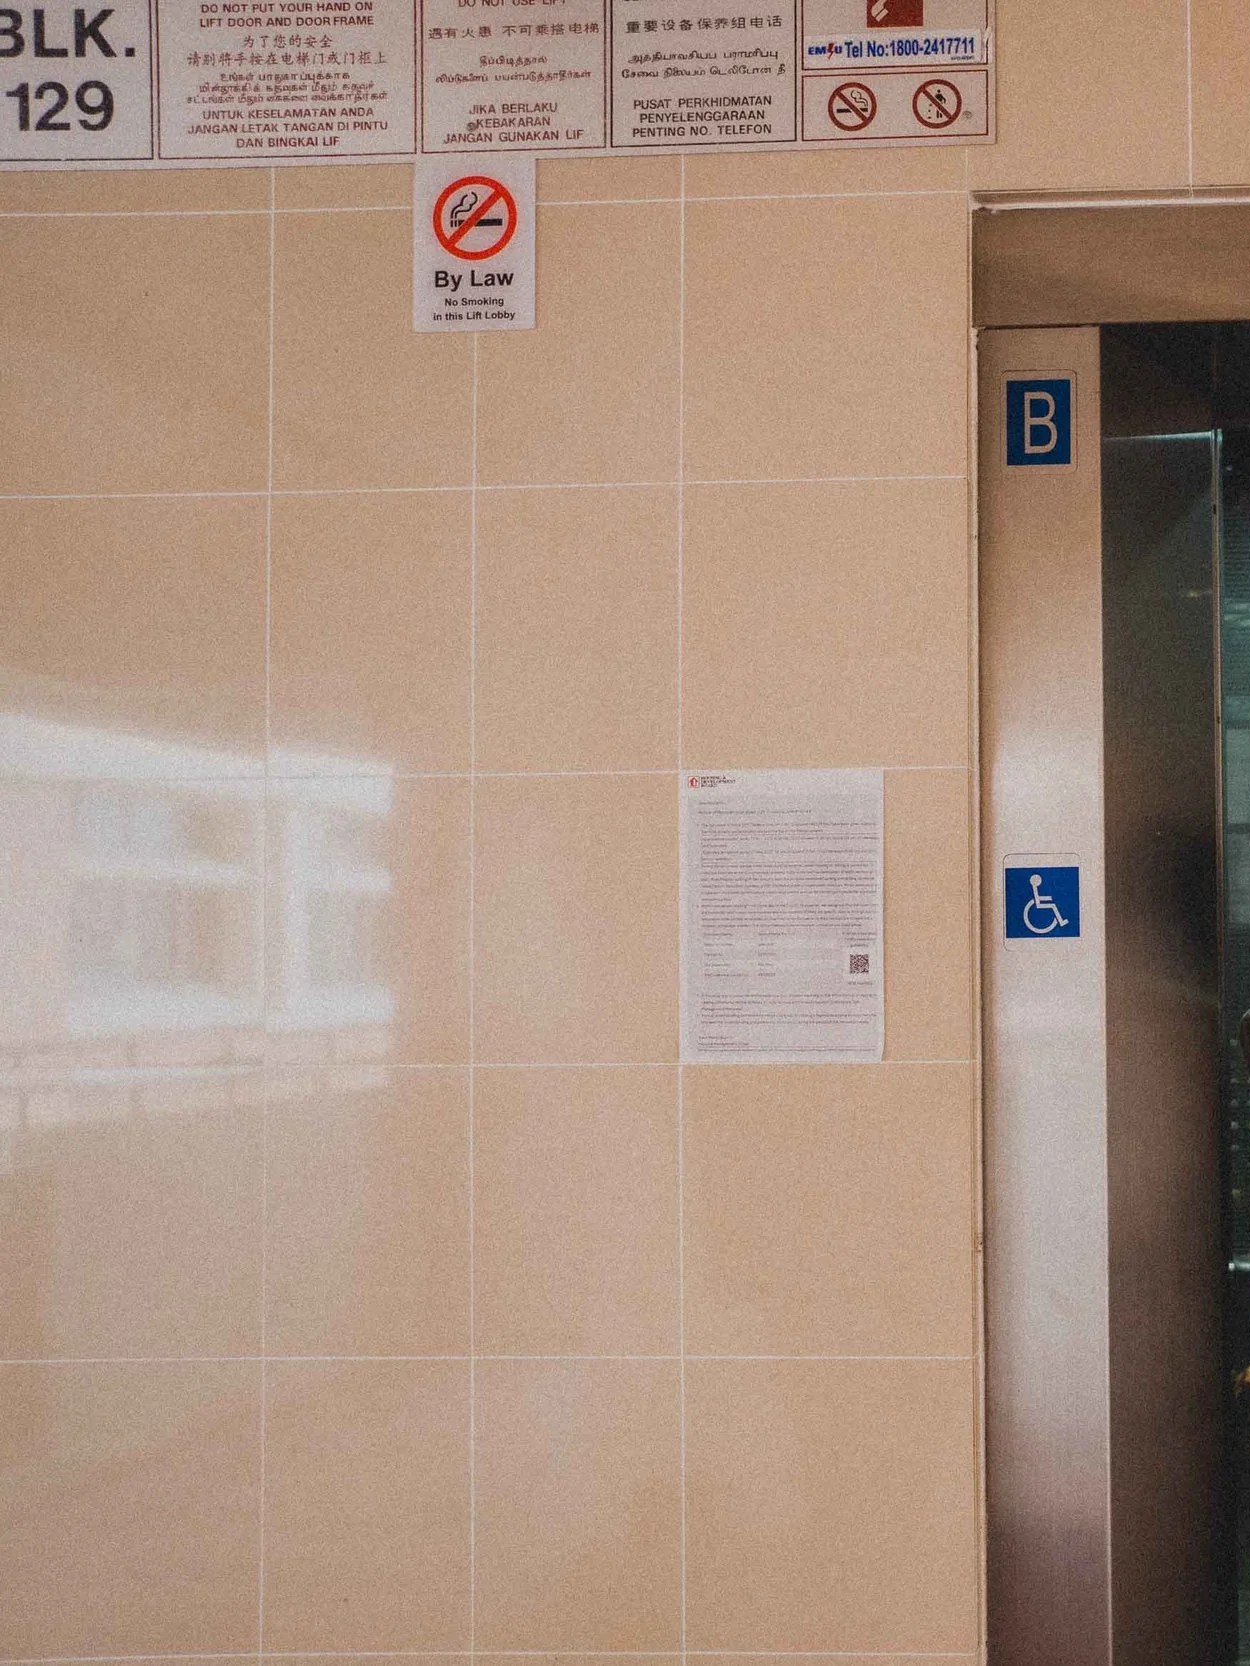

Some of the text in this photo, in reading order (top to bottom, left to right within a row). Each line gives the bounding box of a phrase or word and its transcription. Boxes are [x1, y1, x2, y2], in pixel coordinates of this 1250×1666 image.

[200, 1, 374, 14] DO NOT PUT YOUR HAND ON
[199, 15, 375, 28] LIFT DOOR AND DOOR FRAME
[626, 16, 783, 34] 重要设备保养组电话
[0, 9, 135, 58] BLK.
[428, 23, 600, 39] 遇有火患 不可乘搭电梯
[242, 33, 334, 49] 为了您的安全
[844, 40, 864, 58] Tel
[186, 51, 389, 67] 请别将手按在电梯门或门框上
[6, 80, 114, 131] 129
[468, 102, 559, 116] JIKA BERLAKU
[633, 95, 773, 110] PUSAT PERKHIDMATAN
[202, 107, 375, 120] UNTUK KESELAMATAN ANDA
[640, 110, 765, 123] PENYELENGGARAAN
[187, 121, 389, 135] JANGAN LETAK TANGAN DI PINTU
[476, 116, 552, 129] KEBAKARAN
[443, 129, 585, 145] JANGAN GUNAKAN LIF
[632, 123, 773, 138] PENTING NO. TELEFON
[236, 136, 341, 149] DAN BINGKAI LIF
[435, 270, 514, 292] By Law
[444, 296, 505, 307] No Smoking
[433, 310, 516, 321] in this Lift Lobby
[1024, 391, 1058, 454] B
